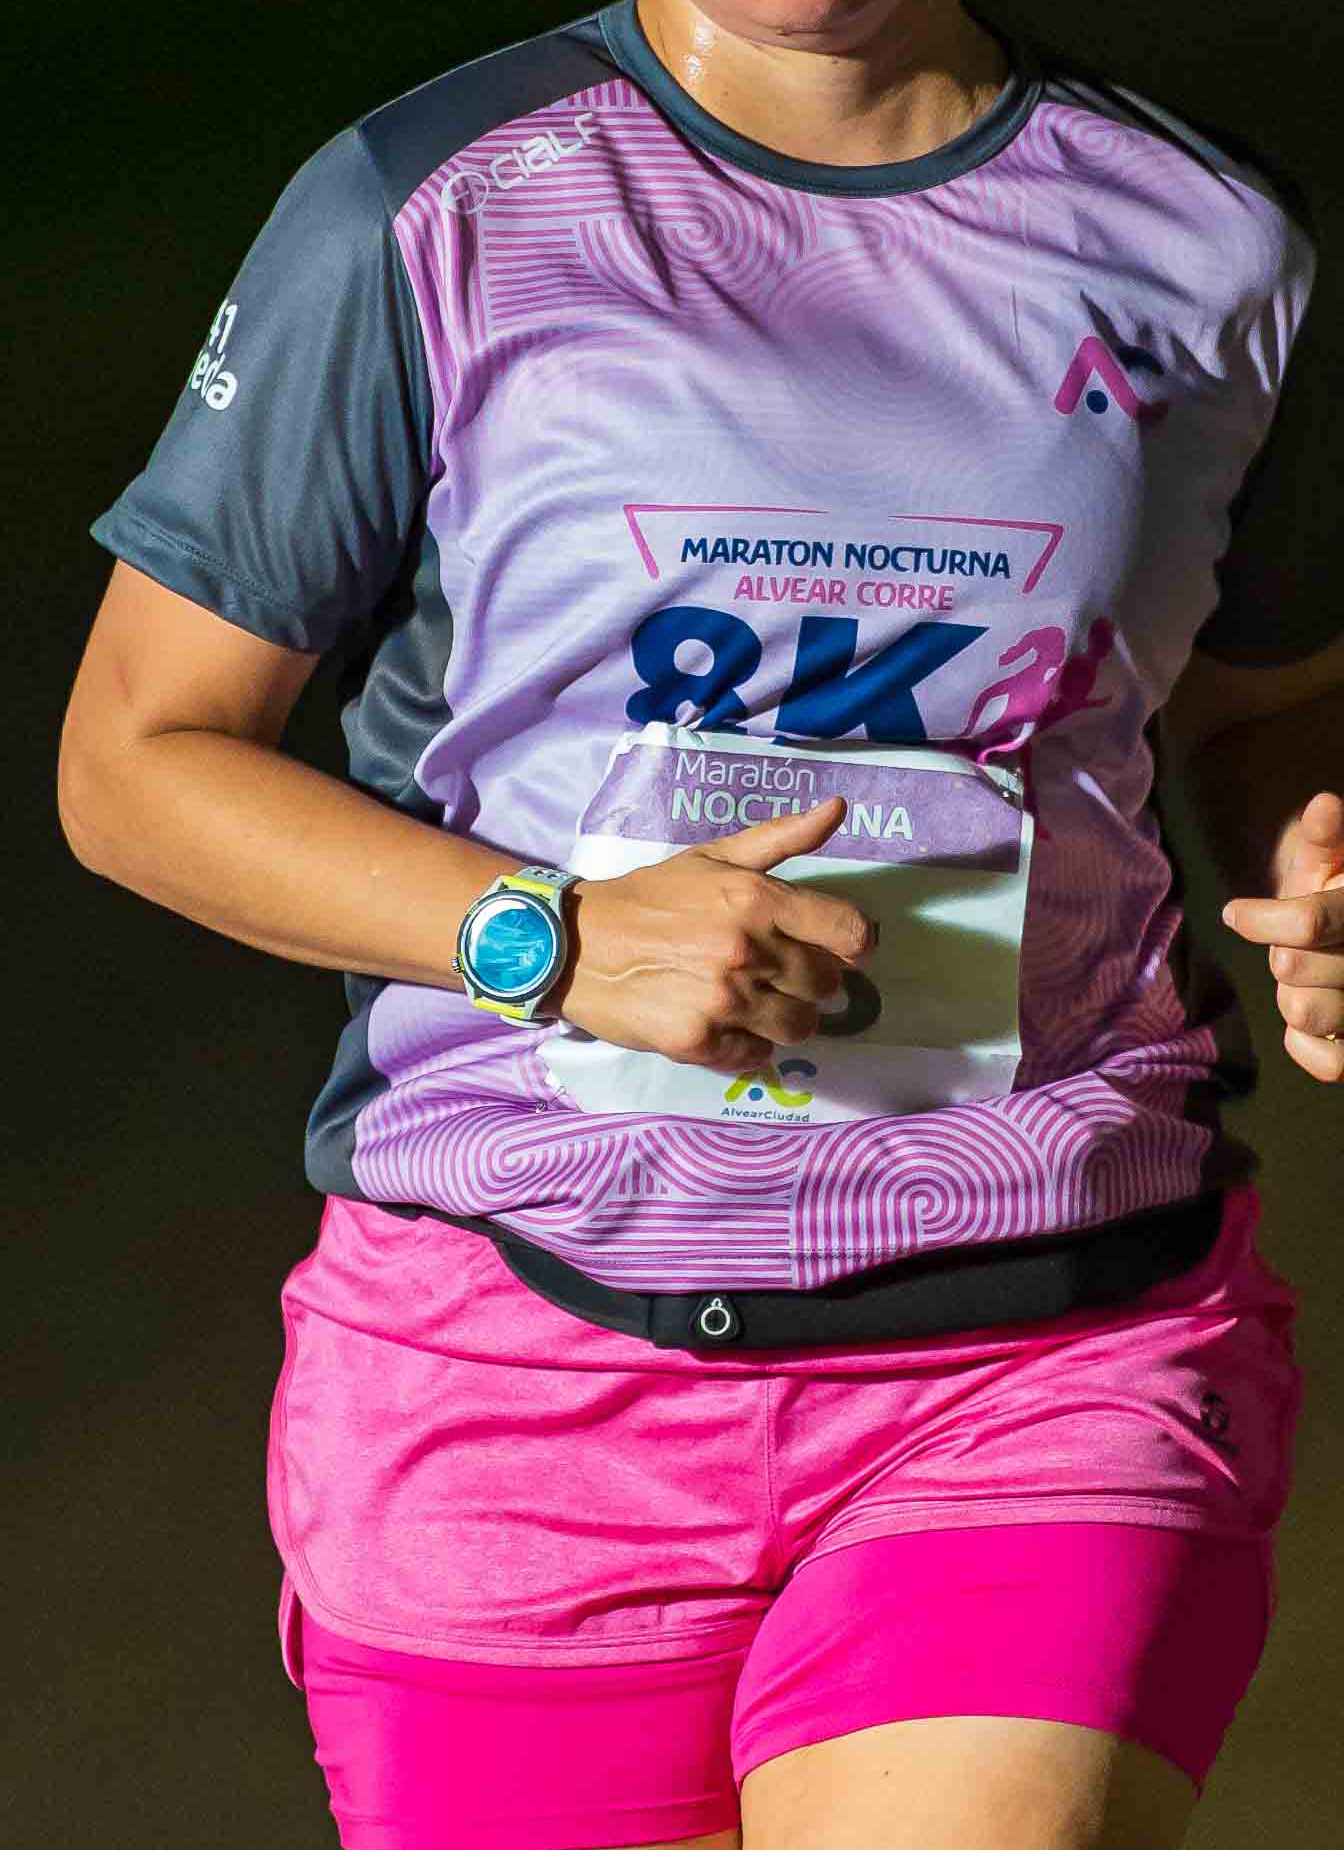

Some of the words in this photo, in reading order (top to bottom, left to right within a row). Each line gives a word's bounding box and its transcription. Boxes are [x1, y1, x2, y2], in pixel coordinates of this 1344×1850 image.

[680, 537, 835, 568] MARATON
[844, 542, 1011, 580] NOCTURNA
[733, 574, 848, 605] ALVEAR
[856, 580, 955, 611] CORRE
[625, 605, 990, 744] 8K
[674, 751, 816, 793] Maratón
[670, 787, 914, 841] NOCTNA
